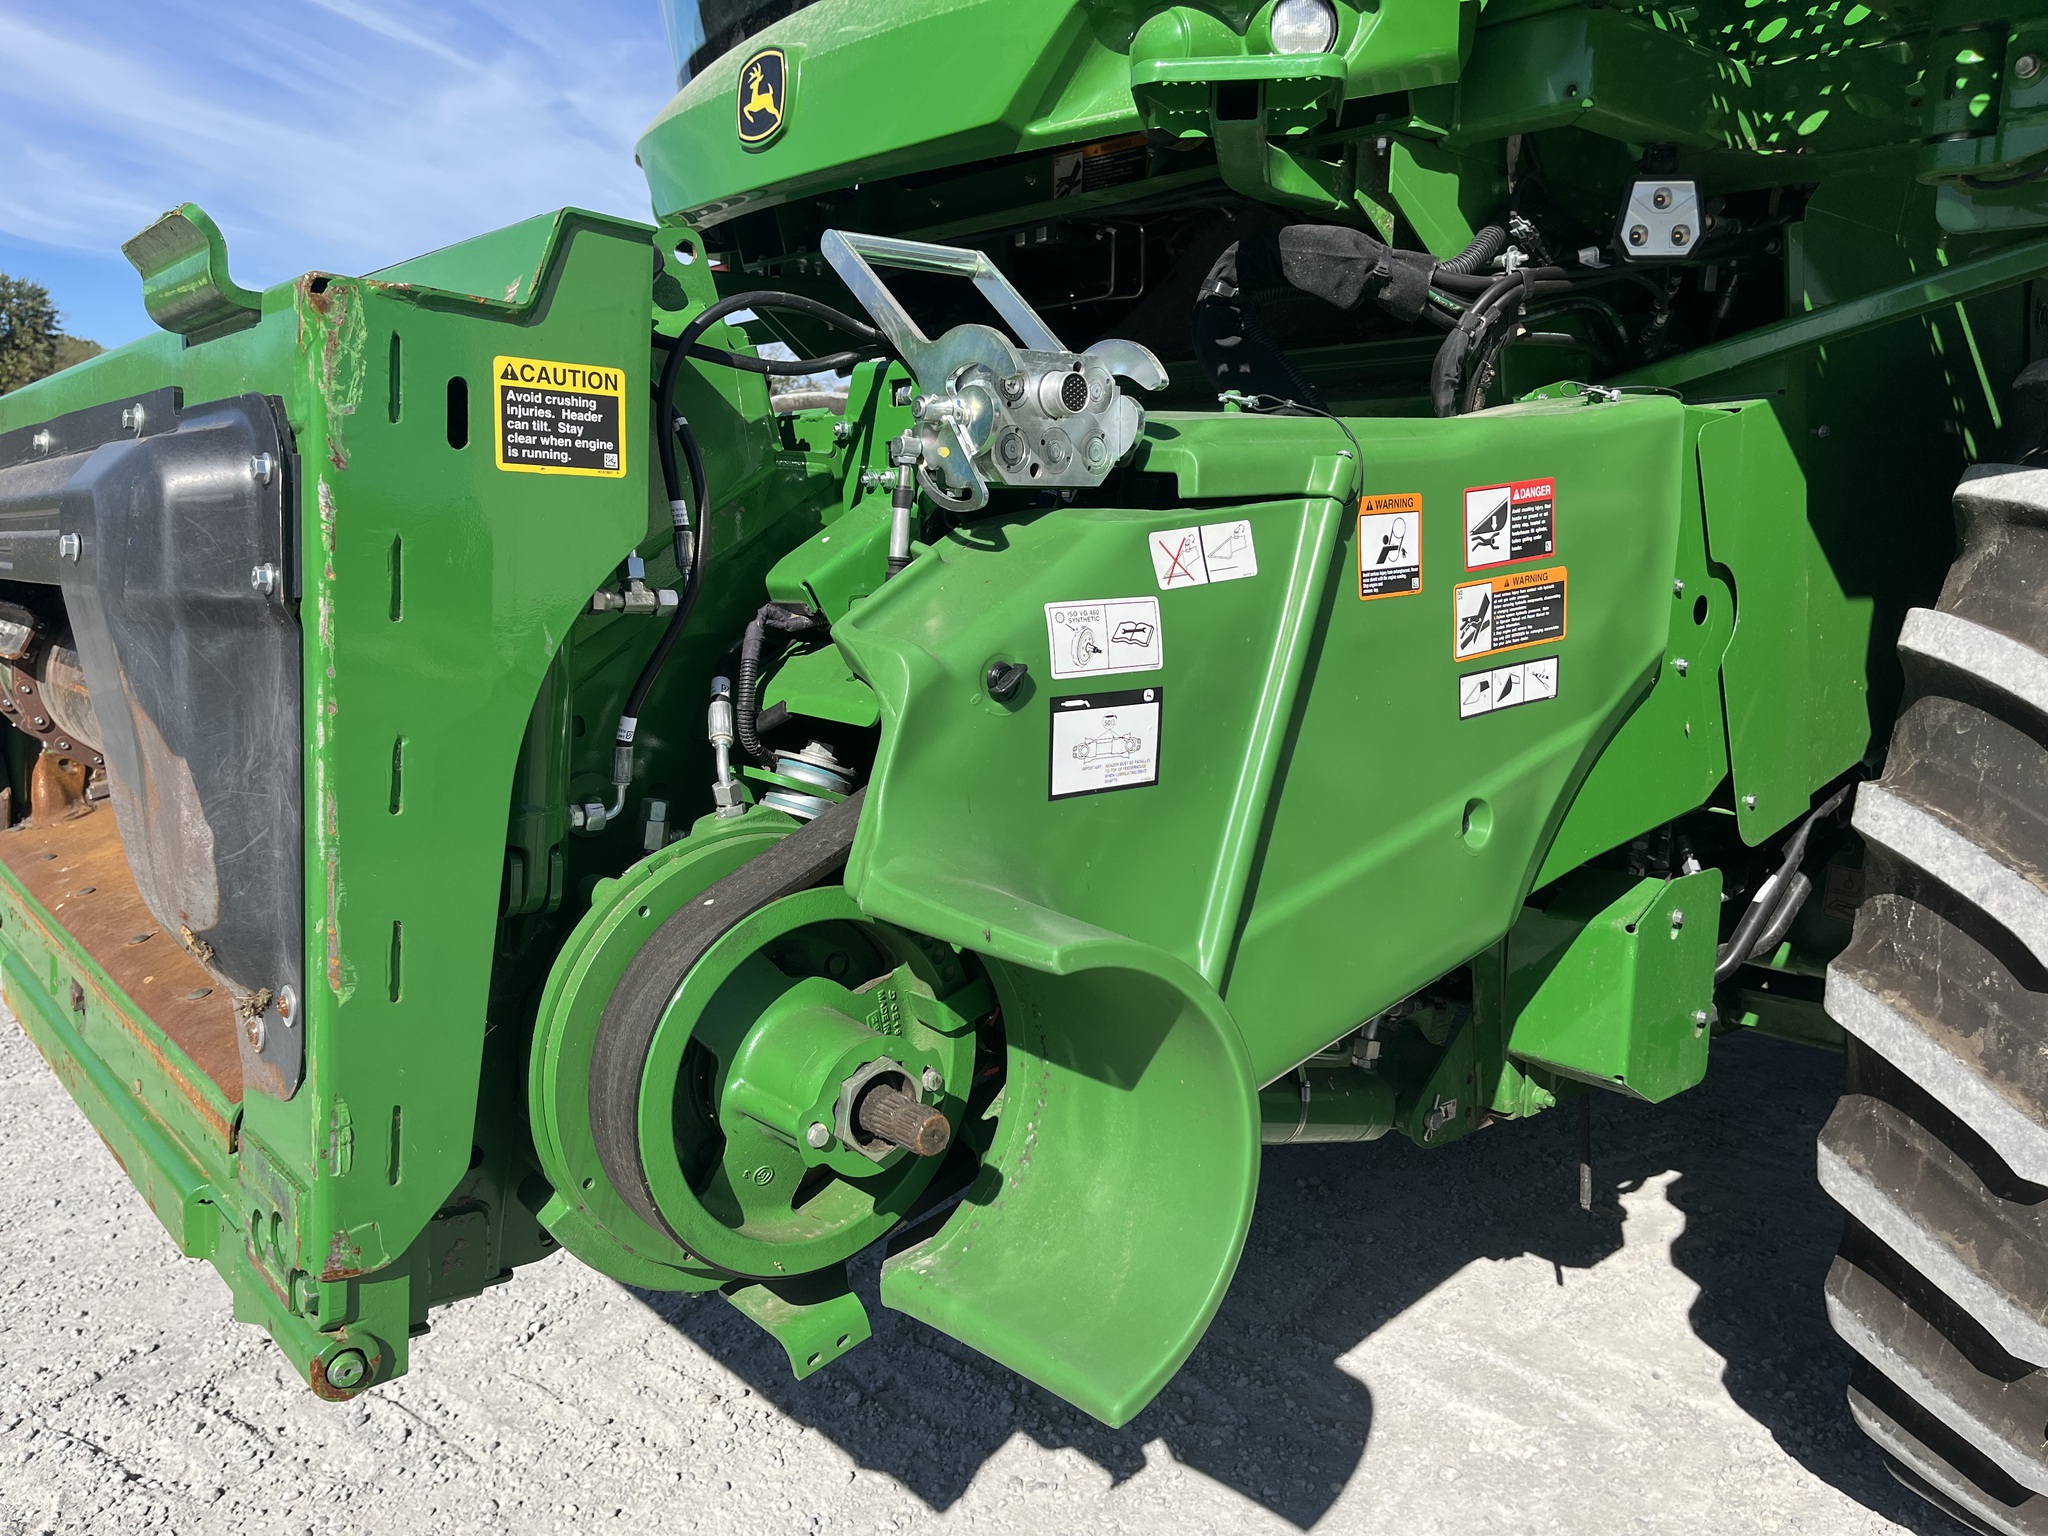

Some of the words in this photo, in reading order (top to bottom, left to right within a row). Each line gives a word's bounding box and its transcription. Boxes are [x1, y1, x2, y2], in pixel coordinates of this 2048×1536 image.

[520, 364, 617, 391] CAUTION
[507, 390, 542, 403] Avoid
[545, 396, 596, 410] crushing
[507, 404, 555, 418] injuries.
[562, 409, 602, 422] Header
[507, 420, 529, 430] can
[532, 421, 551, 432] tilt.
[558, 422, 583, 436] Stay
[508, 433, 537, 444] clear
[540, 435, 572, 447] when
[575, 439, 613, 451] engine
[508, 446, 518, 456] is
[522, 449, 571, 462] running.
[1520, 485, 1550, 498] DANGER
[1375, 498, 1413, 510] WARNING
[1513, 573, 1548, 585] WARNING
[1068, 616, 1100, 624] SYNTHETIC
